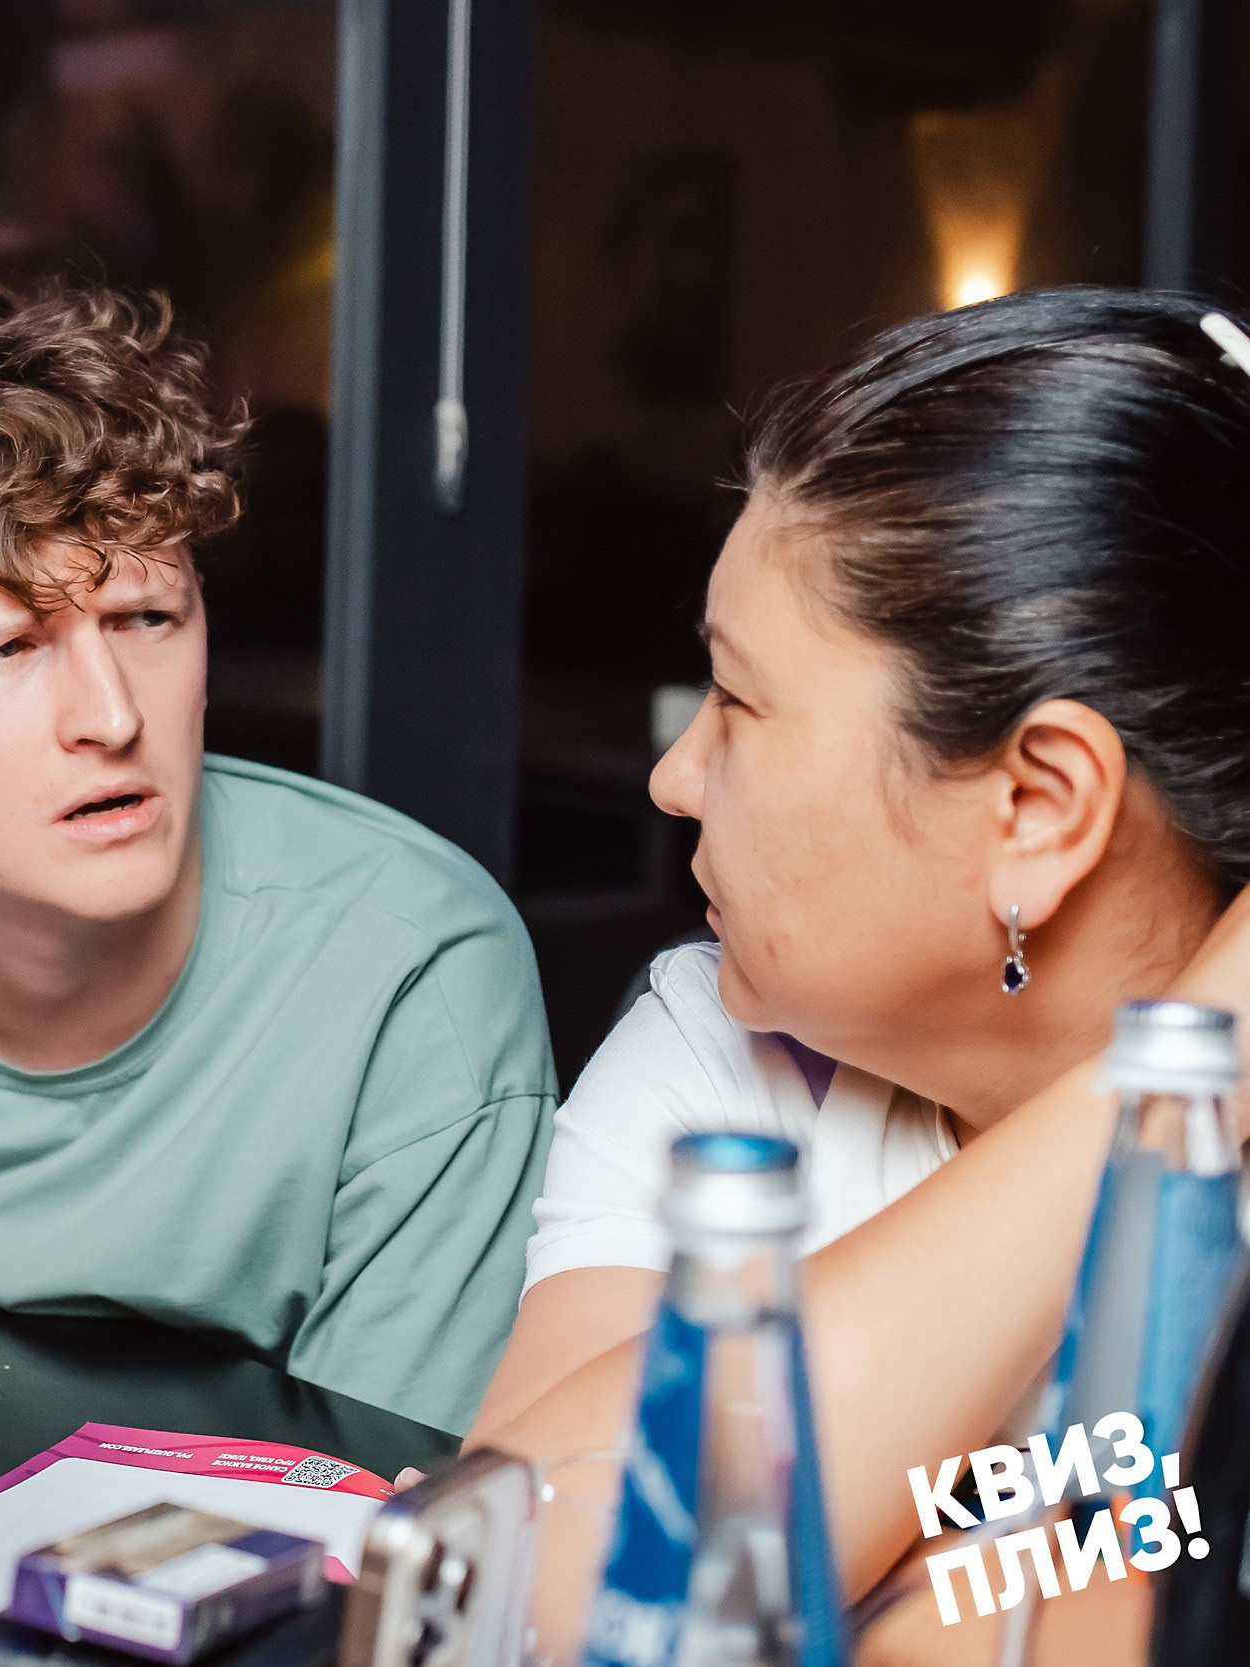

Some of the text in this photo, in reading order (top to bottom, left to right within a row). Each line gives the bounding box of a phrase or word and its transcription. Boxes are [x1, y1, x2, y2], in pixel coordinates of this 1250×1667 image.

[218, 1453, 248, 1461] ПЛИЗ!
[249, 1455, 275, 1464] КВИЗ,
[211, 1460, 288, 1473] САМОЕ ВАЖНОЕ
